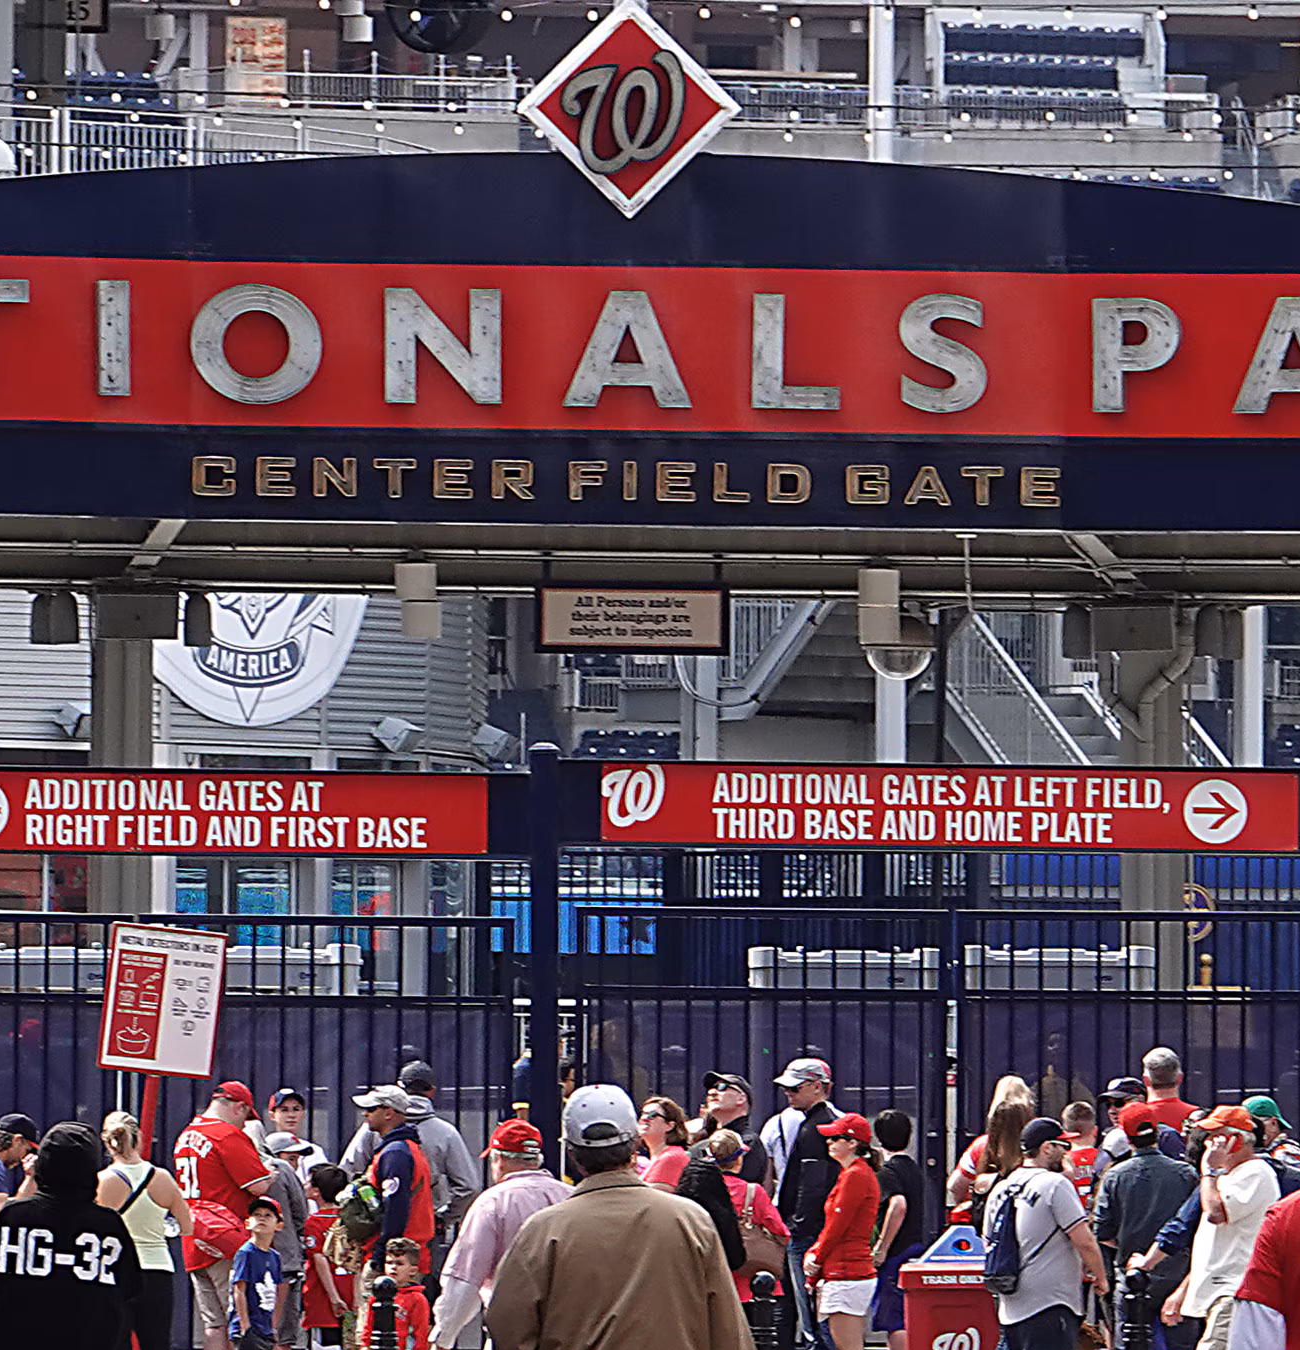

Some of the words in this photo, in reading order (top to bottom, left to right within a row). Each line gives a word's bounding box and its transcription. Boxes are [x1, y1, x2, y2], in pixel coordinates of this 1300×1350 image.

[191, 455, 535, 501] CENTER
[568, 460, 813, 504] FIELD
[846, 464, 1063, 508] GATE
[571, 611, 600, 622] their
[603, 610, 668, 625] belongings
[671, 614, 691, 623] are
[574, 595, 593, 608] All
[597, 595, 644, 608] Persons
[648, 595, 688, 609] and/or
[569, 624, 612, 638] subject
[615, 626, 628, 637] to
[631, 625, 693, 639] inspection
[205, 644, 293, 678] AMERICA
[23, 778, 191, 812] ADDITIONAL
[199, 780, 279, 813] GATES
[282, 781, 324, 813] AT
[712, 772, 875, 805] ADDITIONAL
[882, 775, 966, 807] GATES
[971, 776, 1010, 808] AT
[1016, 777, 1082, 809] LEFT
[1089, 778, 1171, 816] FIELD,
[25, 813, 109, 847] RIGHT
[116, 815, 198, 848] FIELD
[204, 815, 262, 848] AND
[269, 816, 350, 849] FIRST
[357, 817, 428, 850] BASE
[713, 807, 795, 840] THIRD
[804, 808, 875, 841] BASE
[881, 809, 937, 842] AND
[944, 810, 1023, 843] HOME
[1032, 811, 1113, 845] PLATE
[119, 934, 145, 947] METAL
[146, 937, 190, 952] DETECTORS
[193, 942, 219, 955] IN-USE
[175, 1156, 201, 1199] 31
[921, 1275, 958, 1285] TRASH
